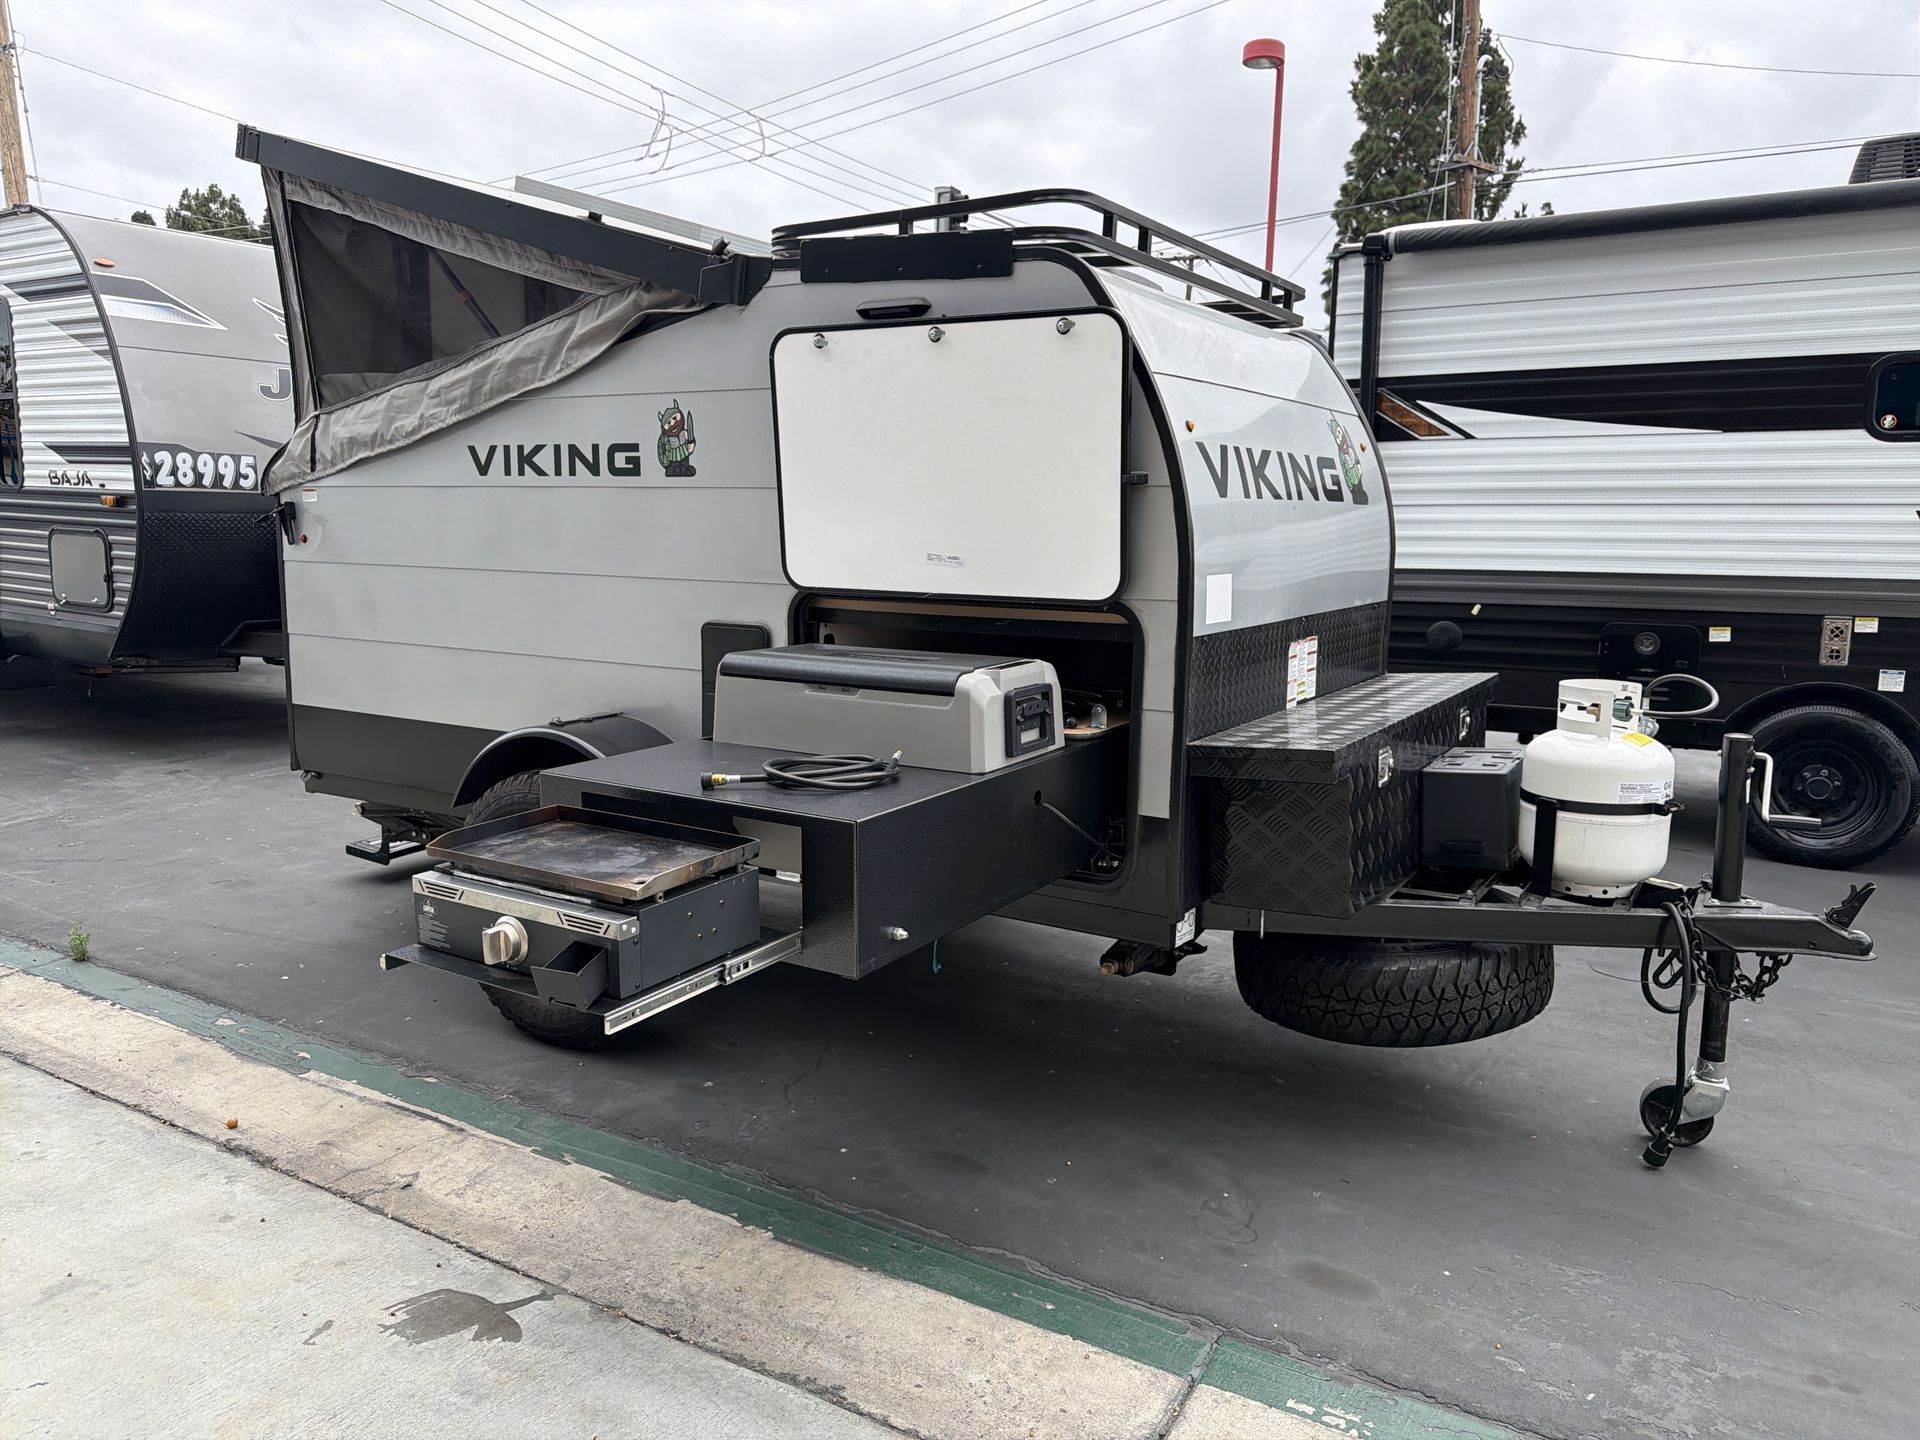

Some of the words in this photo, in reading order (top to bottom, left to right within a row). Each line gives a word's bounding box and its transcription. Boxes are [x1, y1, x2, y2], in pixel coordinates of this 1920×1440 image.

[467, 443, 641, 477] VIKING
[1195, 441, 1344, 502] VIKING
[48, 470, 93, 487] BAJA
